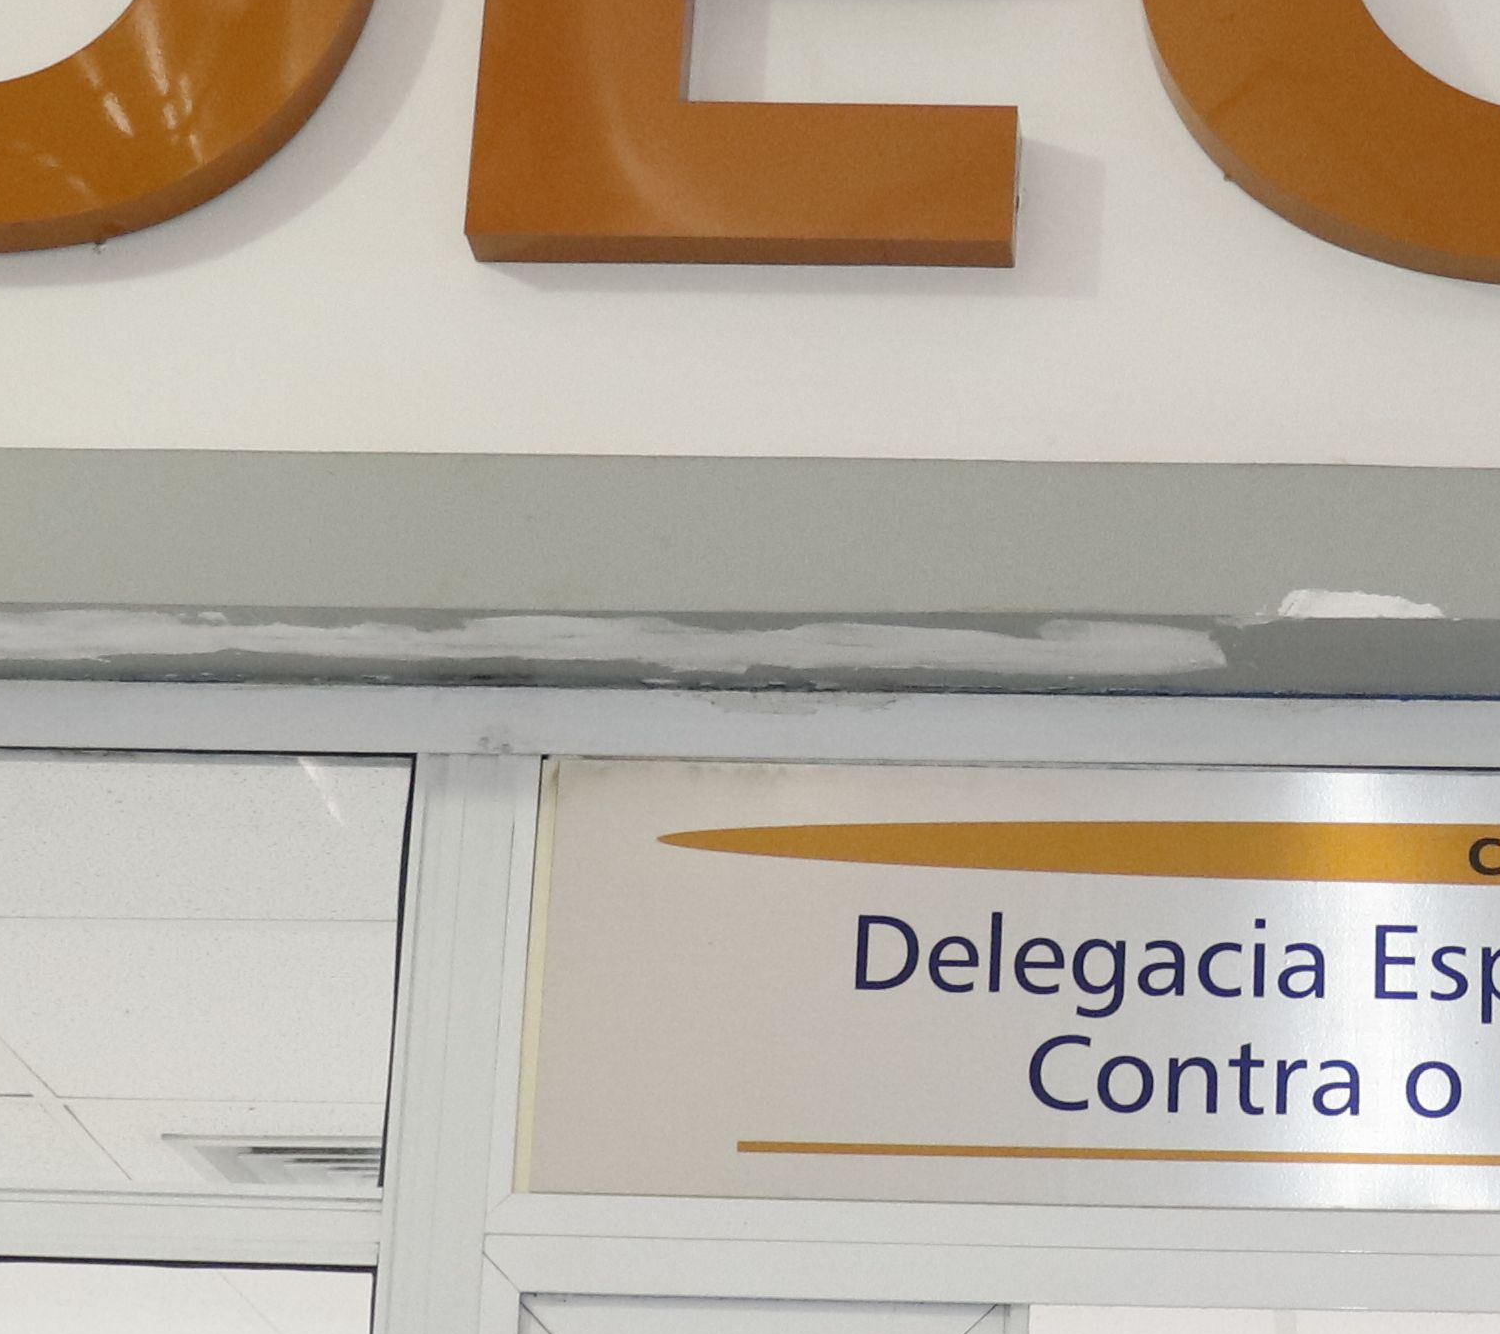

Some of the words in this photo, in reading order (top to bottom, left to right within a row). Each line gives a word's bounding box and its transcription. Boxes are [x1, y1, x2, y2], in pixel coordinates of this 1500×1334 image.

[852, 910, 1327, 1018] Delegacia
[1027, 1033, 1361, 1118] Contra
[1404, 1059, 1463, 1120] o
